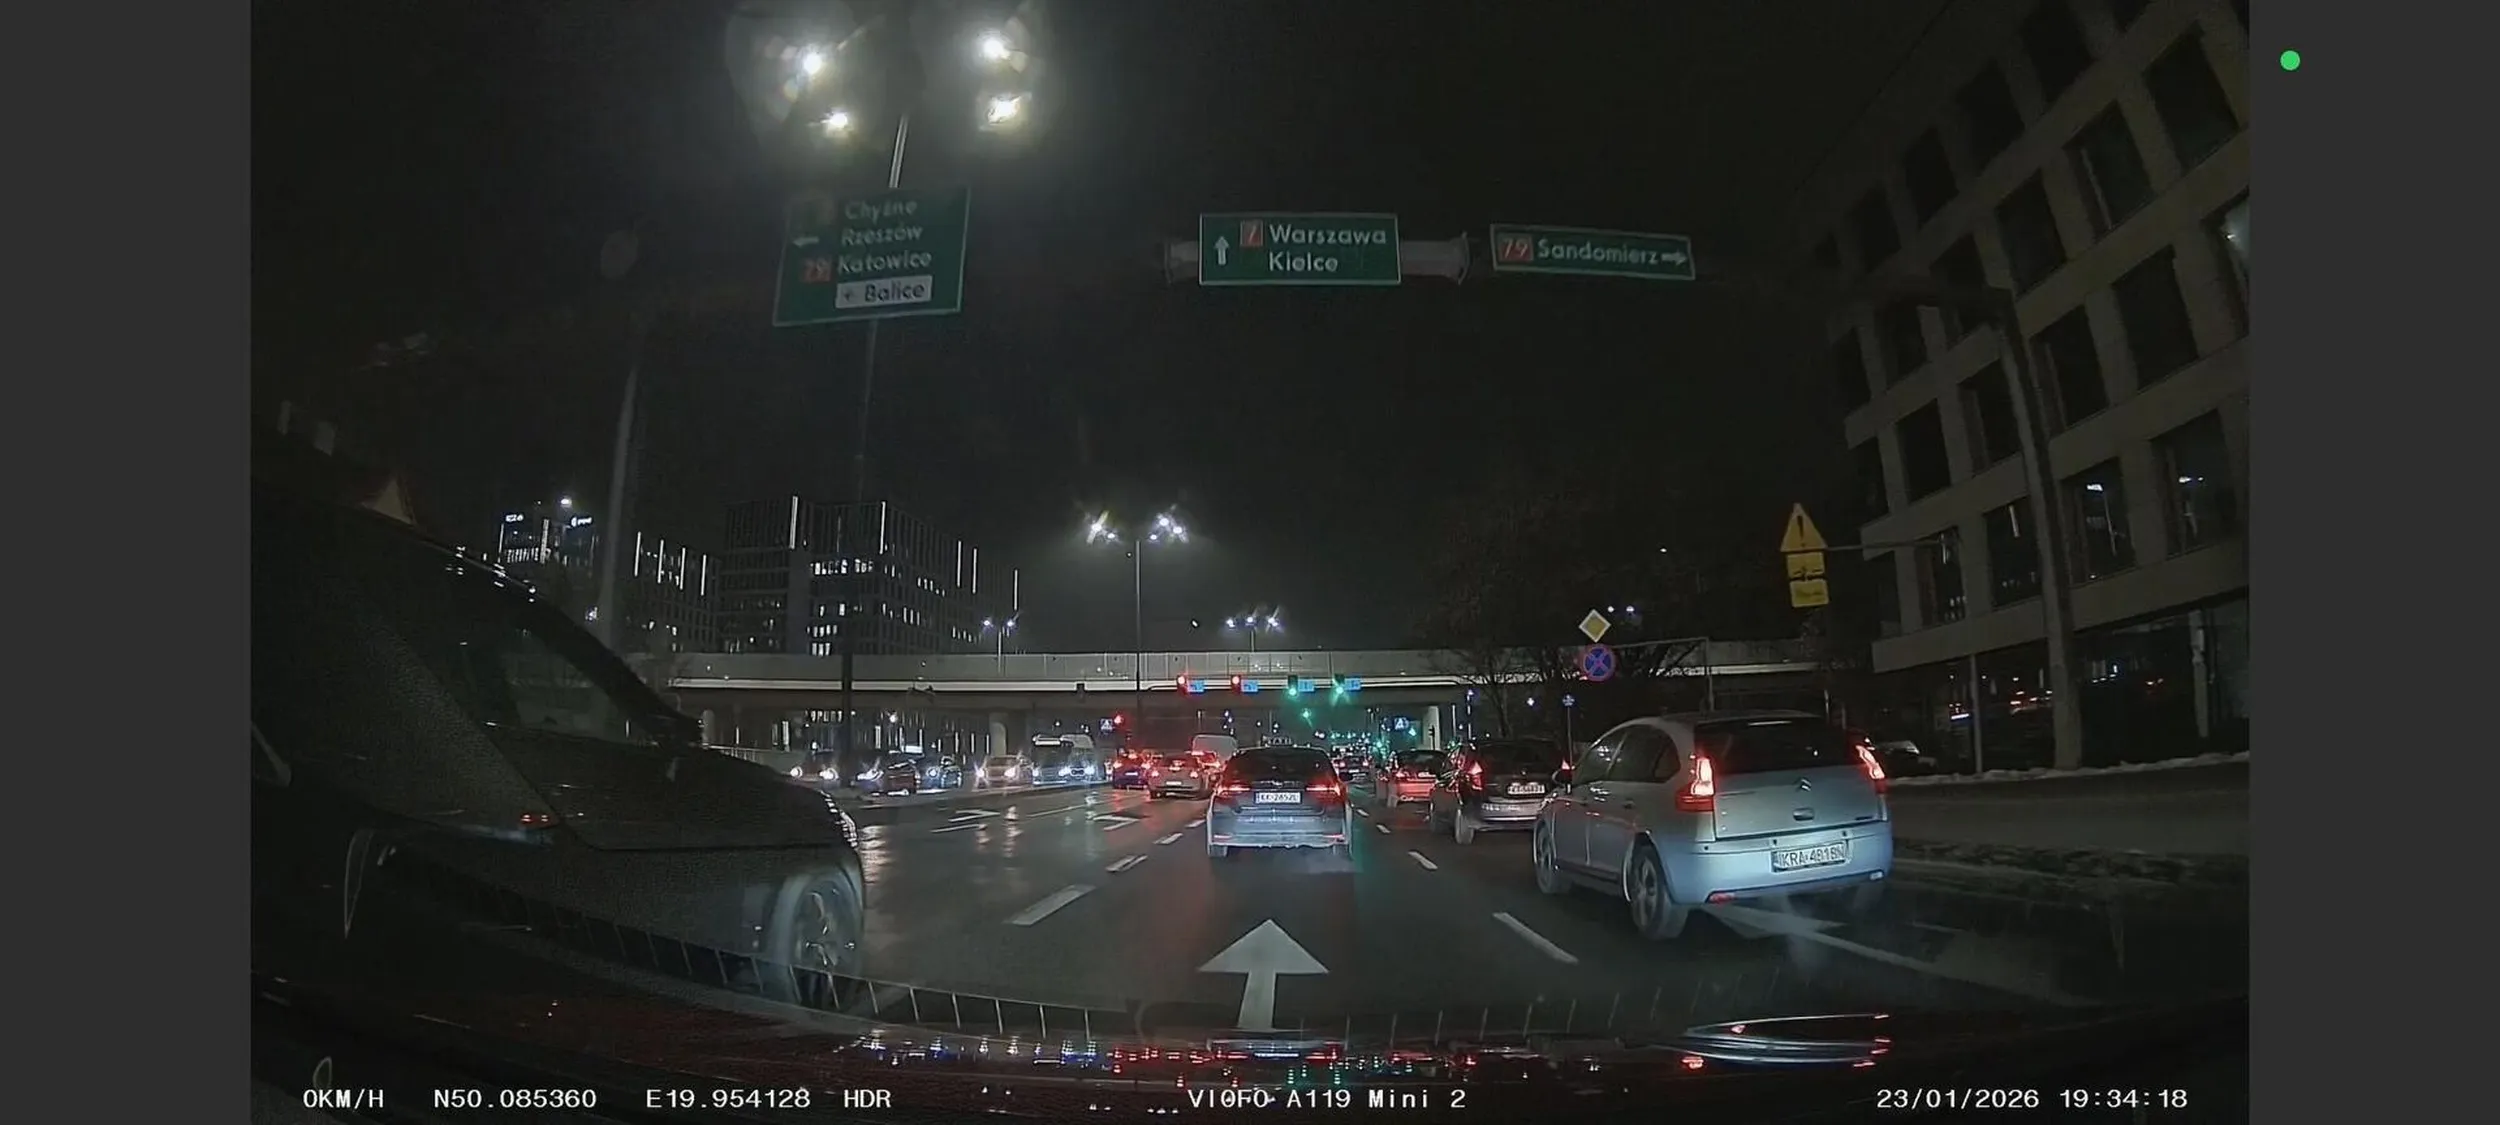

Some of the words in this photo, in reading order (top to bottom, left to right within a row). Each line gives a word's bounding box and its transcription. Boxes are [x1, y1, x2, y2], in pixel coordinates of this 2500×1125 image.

[840, 223, 924, 247] Rzeszów
[1268, 223, 1388, 245] Warszawa
[837, 250, 933, 275] Katowice
[1268, 251, 1339, 273] Kielce
[1503, 237, 1530, 259] 79
[1536, 236, 1659, 266] Sandomierz
[864, 280, 926, 303] Balice
